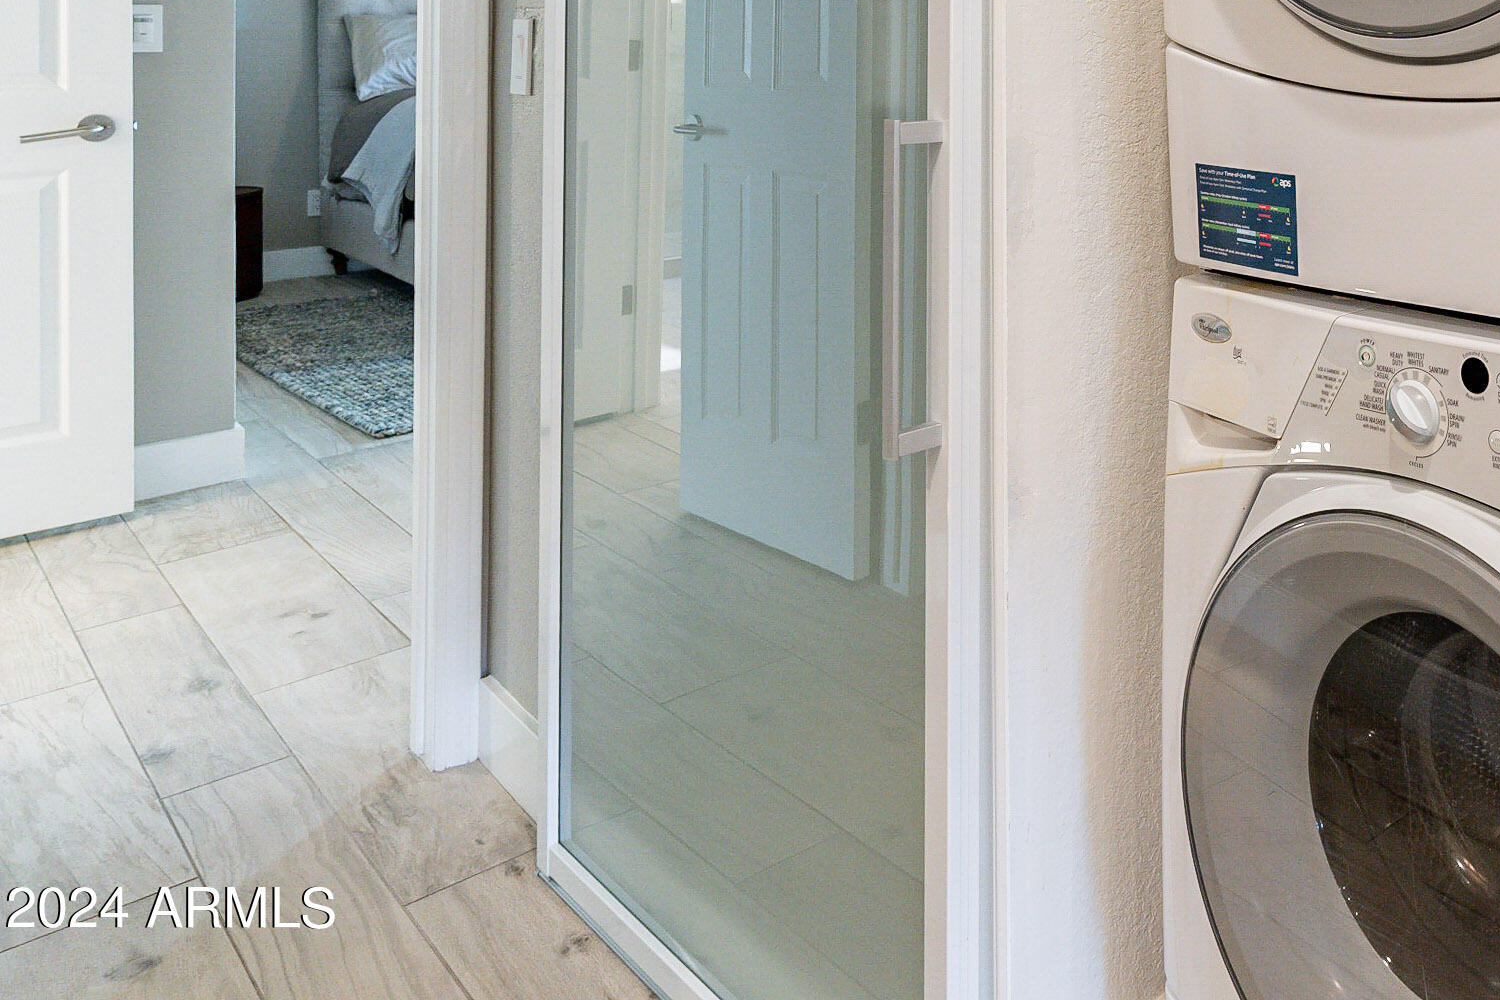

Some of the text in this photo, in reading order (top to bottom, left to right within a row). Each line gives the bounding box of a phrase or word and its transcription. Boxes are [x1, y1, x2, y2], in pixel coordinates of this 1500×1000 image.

[1279, 179, 1291, 188] aps
[1407, 351, 1425, 359] WHITEST
[1408, 359, 1424, 367] WHITES
[1428, 366, 1449, 375] SANITARY
[1374, 371, 1389, 380] CASUAL
[1374, 380, 1387, 388] QUICK
[1360, 401, 1384, 411] HAND WASH
[1447, 398, 1458, 407] SOAK
[1356, 414, 1385, 426] CLEAN WASHER
[1450, 420, 1459, 429] SPIN
[1447, 440, 1457, 448] SPIN
